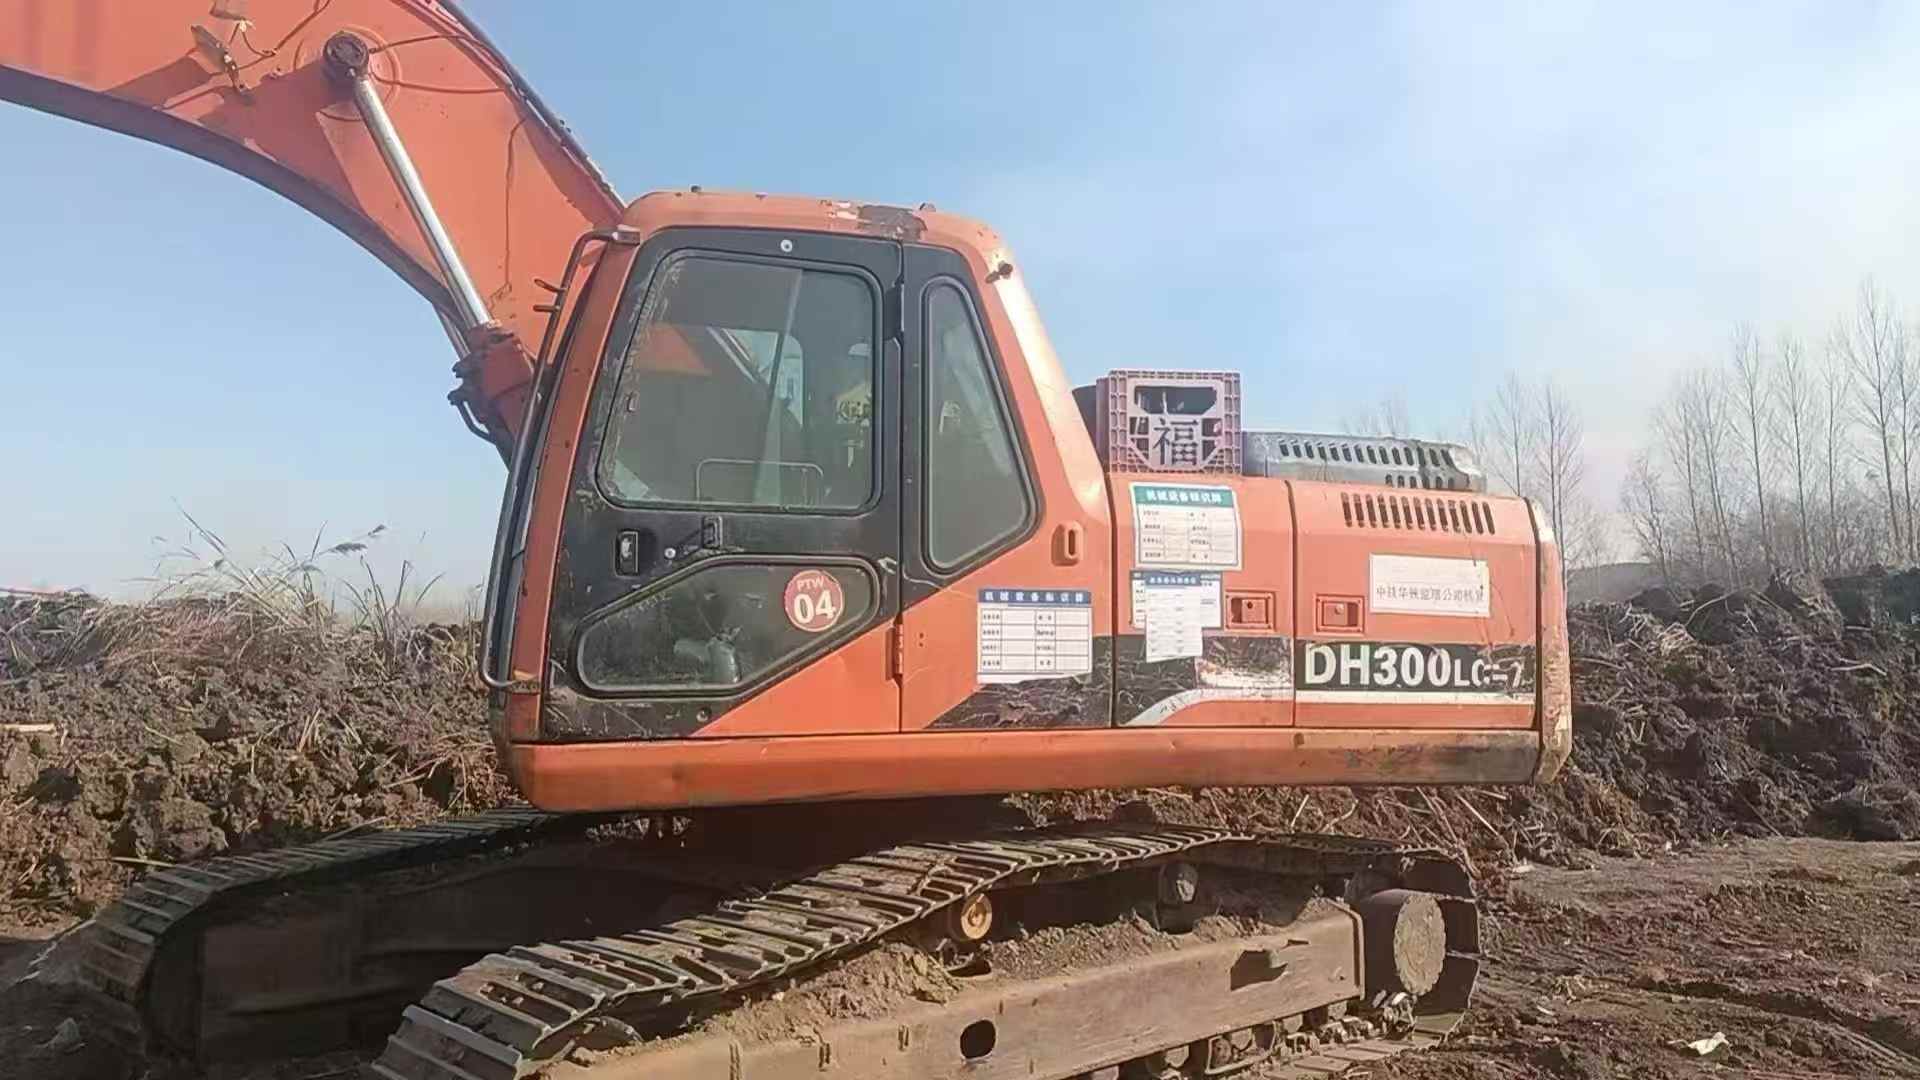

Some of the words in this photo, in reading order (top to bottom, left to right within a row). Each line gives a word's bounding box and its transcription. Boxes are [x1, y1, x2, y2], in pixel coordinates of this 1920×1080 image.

[1153, 417, 1199, 466] 福
[796, 575, 825, 591] PTW
[793, 590, 837, 624] 04
